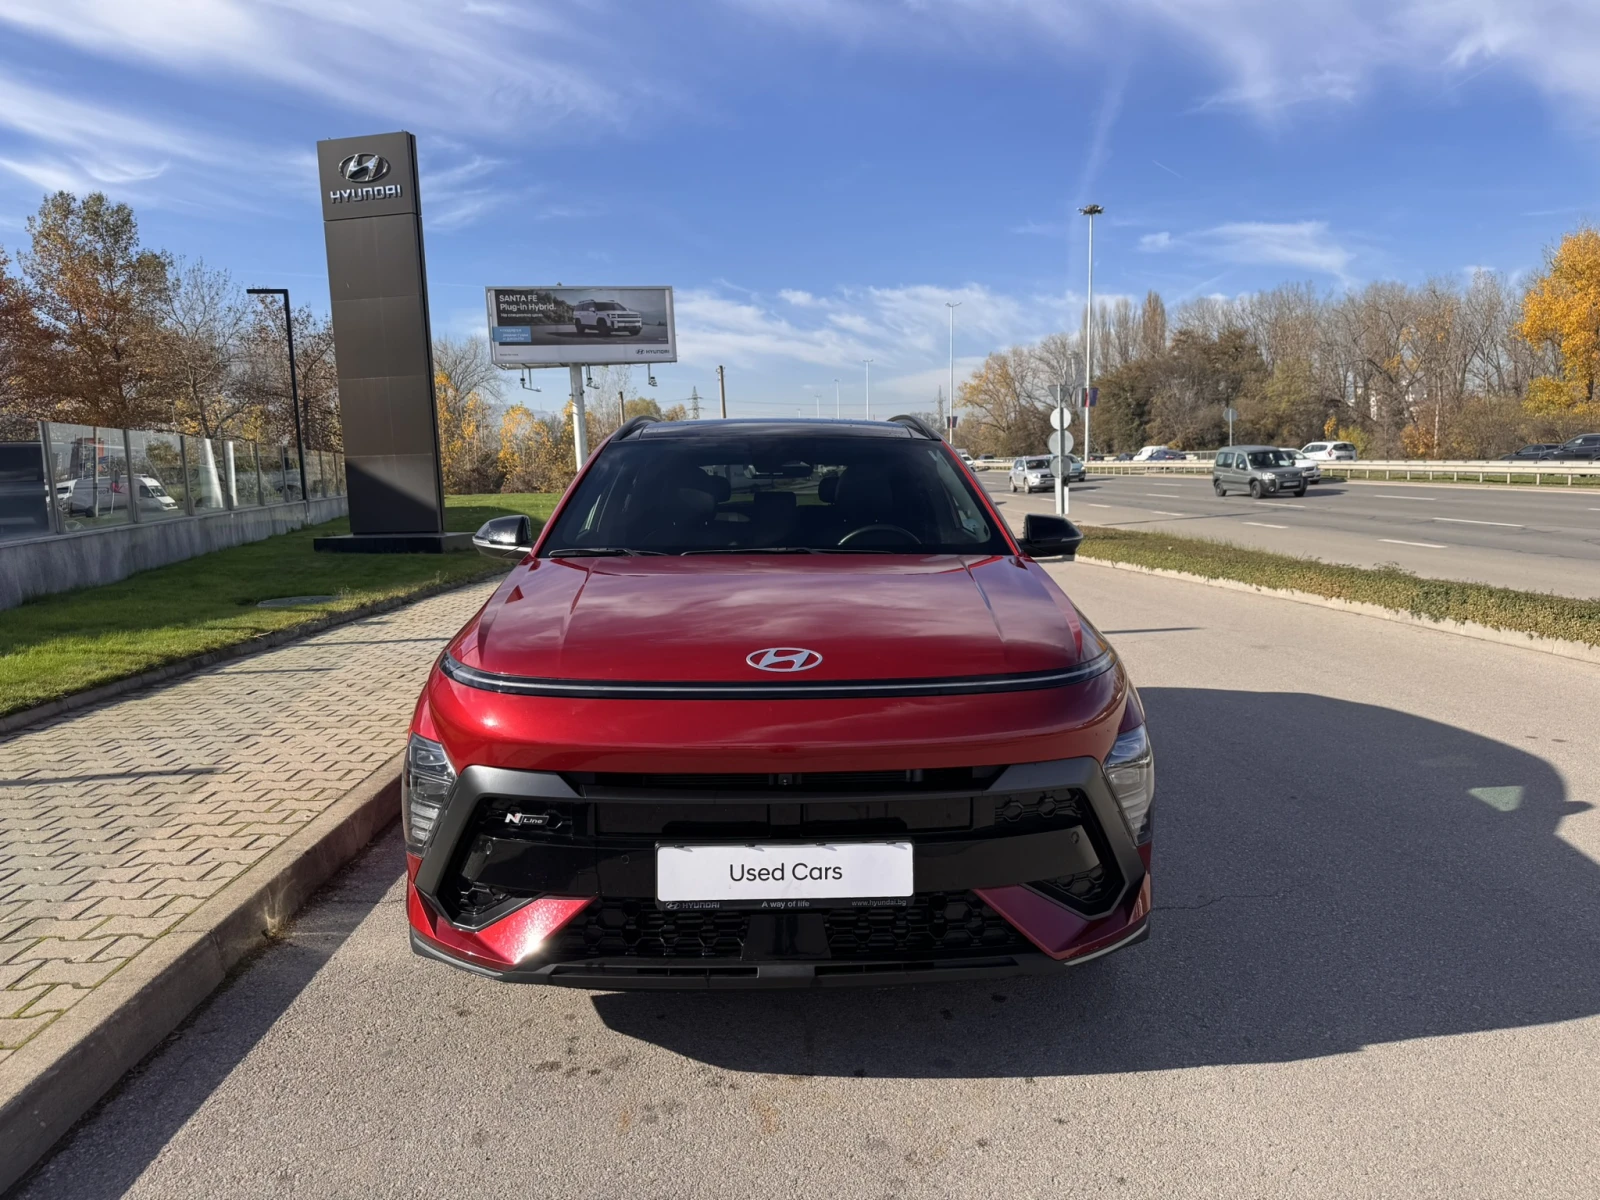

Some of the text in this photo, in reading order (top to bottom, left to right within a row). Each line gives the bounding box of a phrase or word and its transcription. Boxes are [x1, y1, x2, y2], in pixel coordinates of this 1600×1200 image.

[330, 184, 402, 204] HYUNDAI
[499, 294, 527, 302] SANTA
[500, 303, 557, 312] Plug-in Hybrid.
[504, 812, 522, 824] N
[729, 862, 843, 882] Used Cars
[787, 900, 796, 908] of
[797, 900, 810, 908] life
[851, 899, 907, 908] www.hyundai.bg
